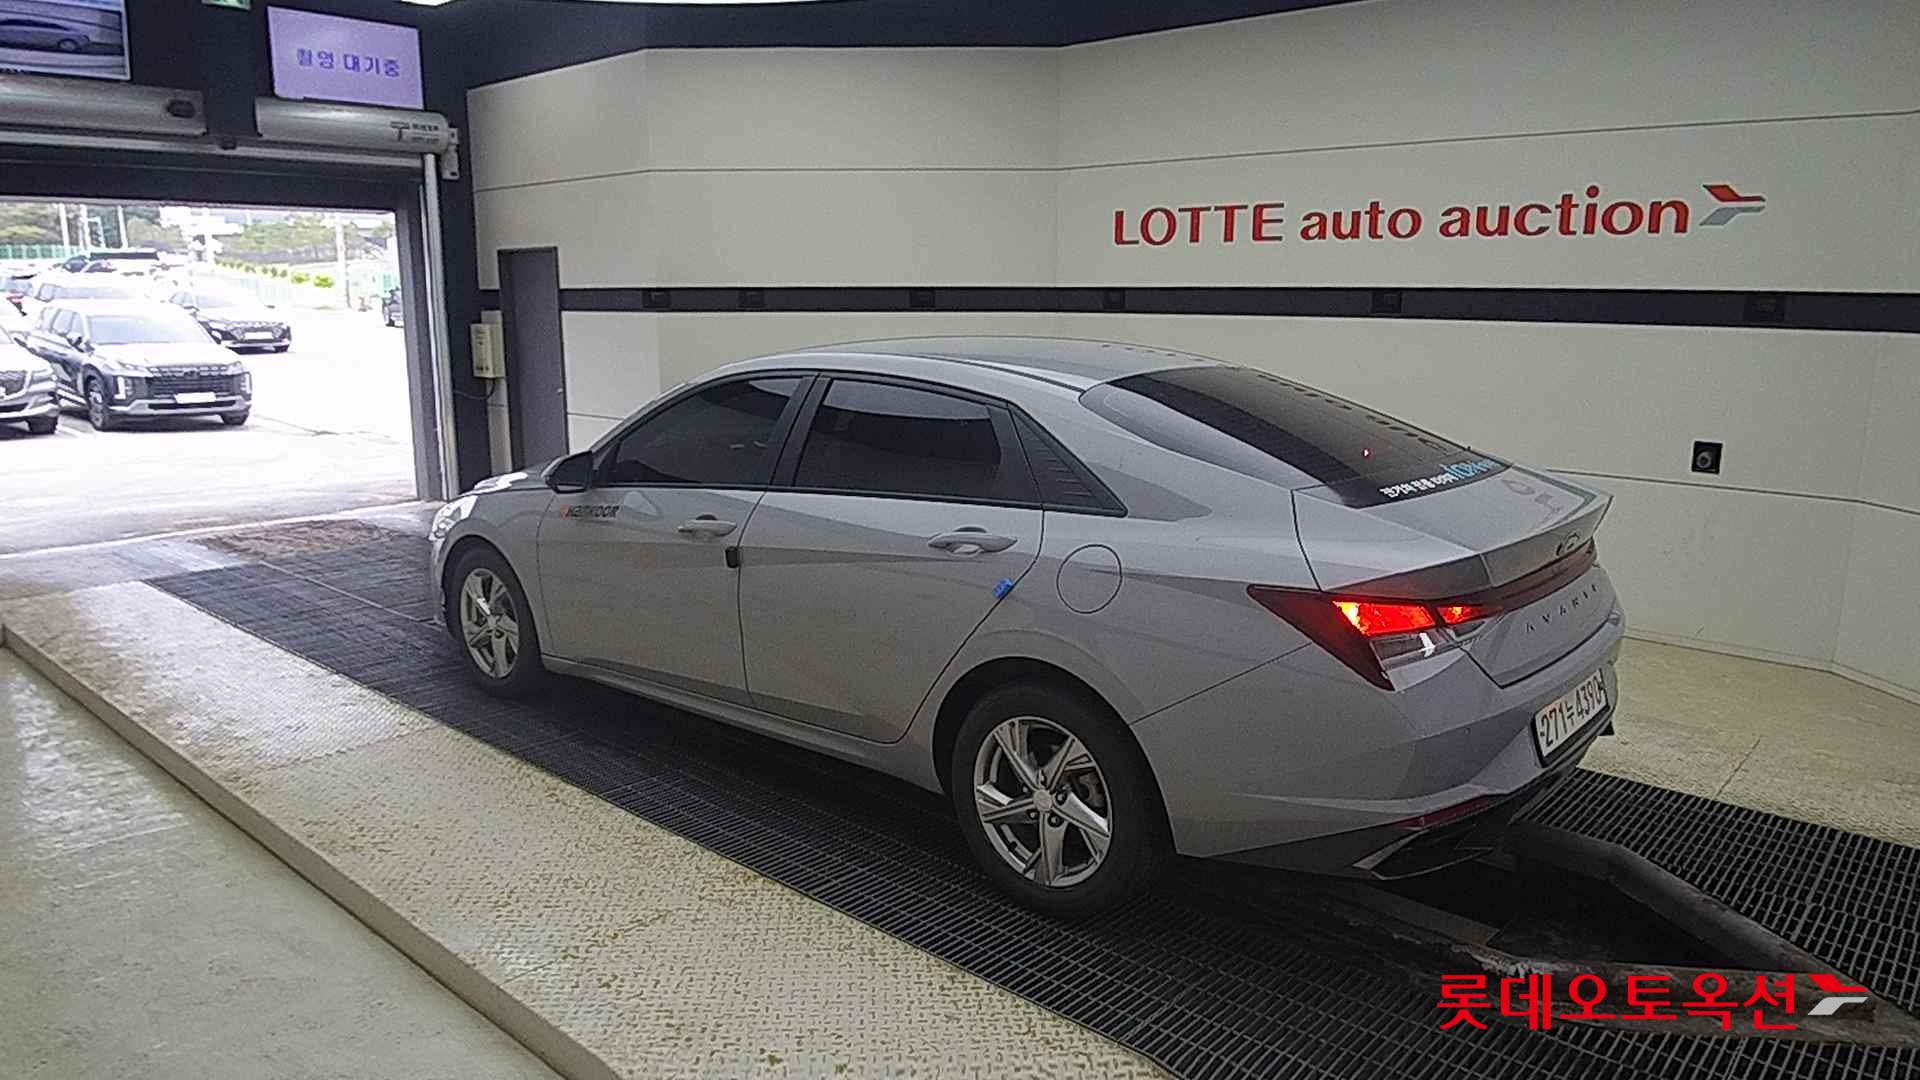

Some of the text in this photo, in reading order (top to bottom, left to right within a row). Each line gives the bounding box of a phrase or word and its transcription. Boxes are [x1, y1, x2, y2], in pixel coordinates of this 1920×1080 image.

[343, 54, 400, 77] 대기중
[1114, 184, 1690, 246] LOTTE auto auction
